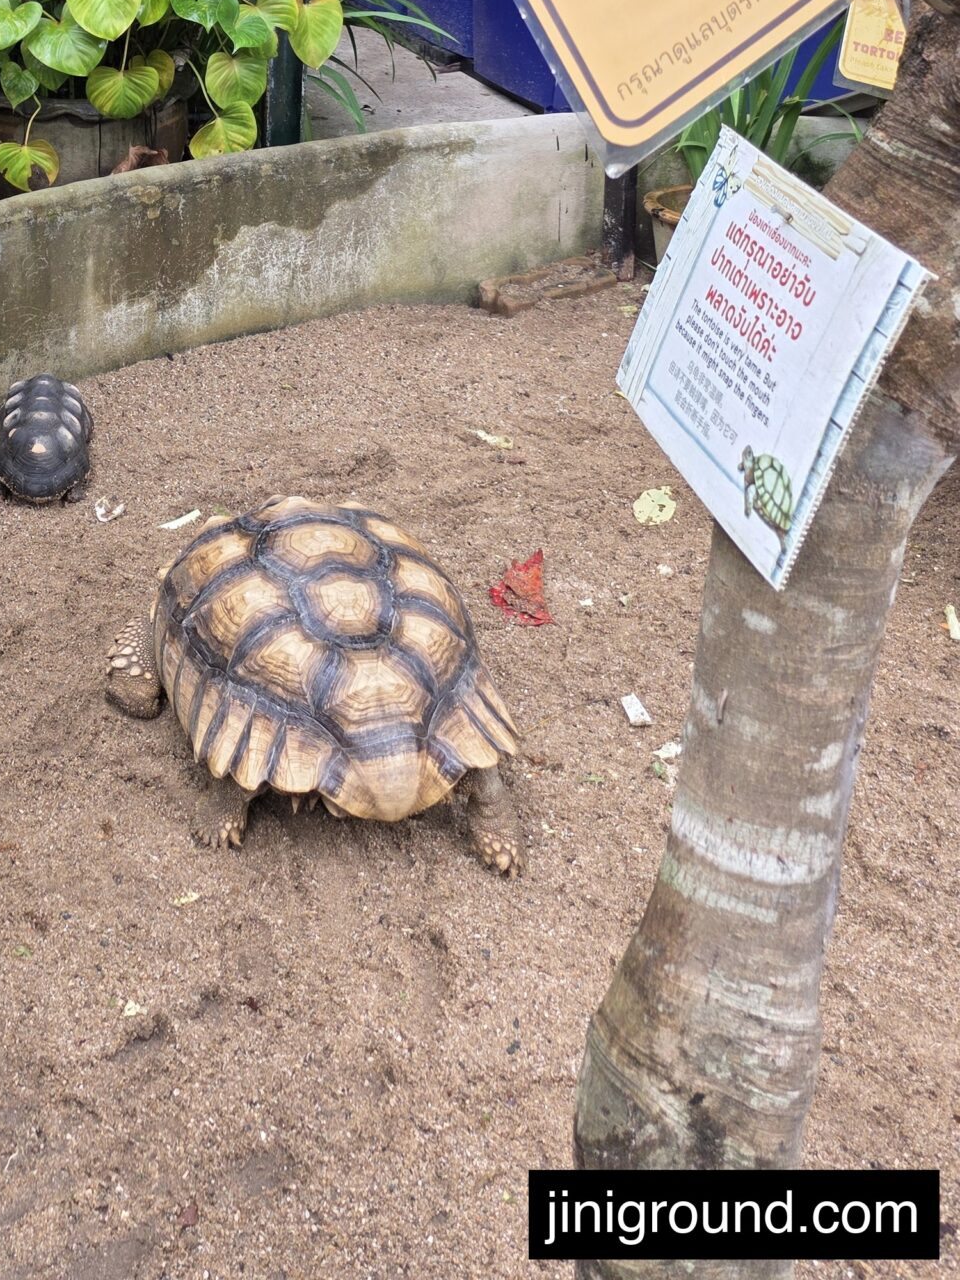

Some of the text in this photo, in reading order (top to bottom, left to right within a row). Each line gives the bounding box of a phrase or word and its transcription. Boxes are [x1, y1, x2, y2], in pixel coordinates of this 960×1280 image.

[711, 245, 803, 341] ปากเต่าเพราะอาจ
[725, 221, 816, 307] แต่กรุณาอย่าจับ
[685, 314, 771, 407] please don't touch the mouth
[691, 299, 777, 392] The tortoise is very tame. But
[705, 284, 777, 363] พลาดงับได้ค่ะ
[675, 318, 769, 428] because it might snap the fingers.
